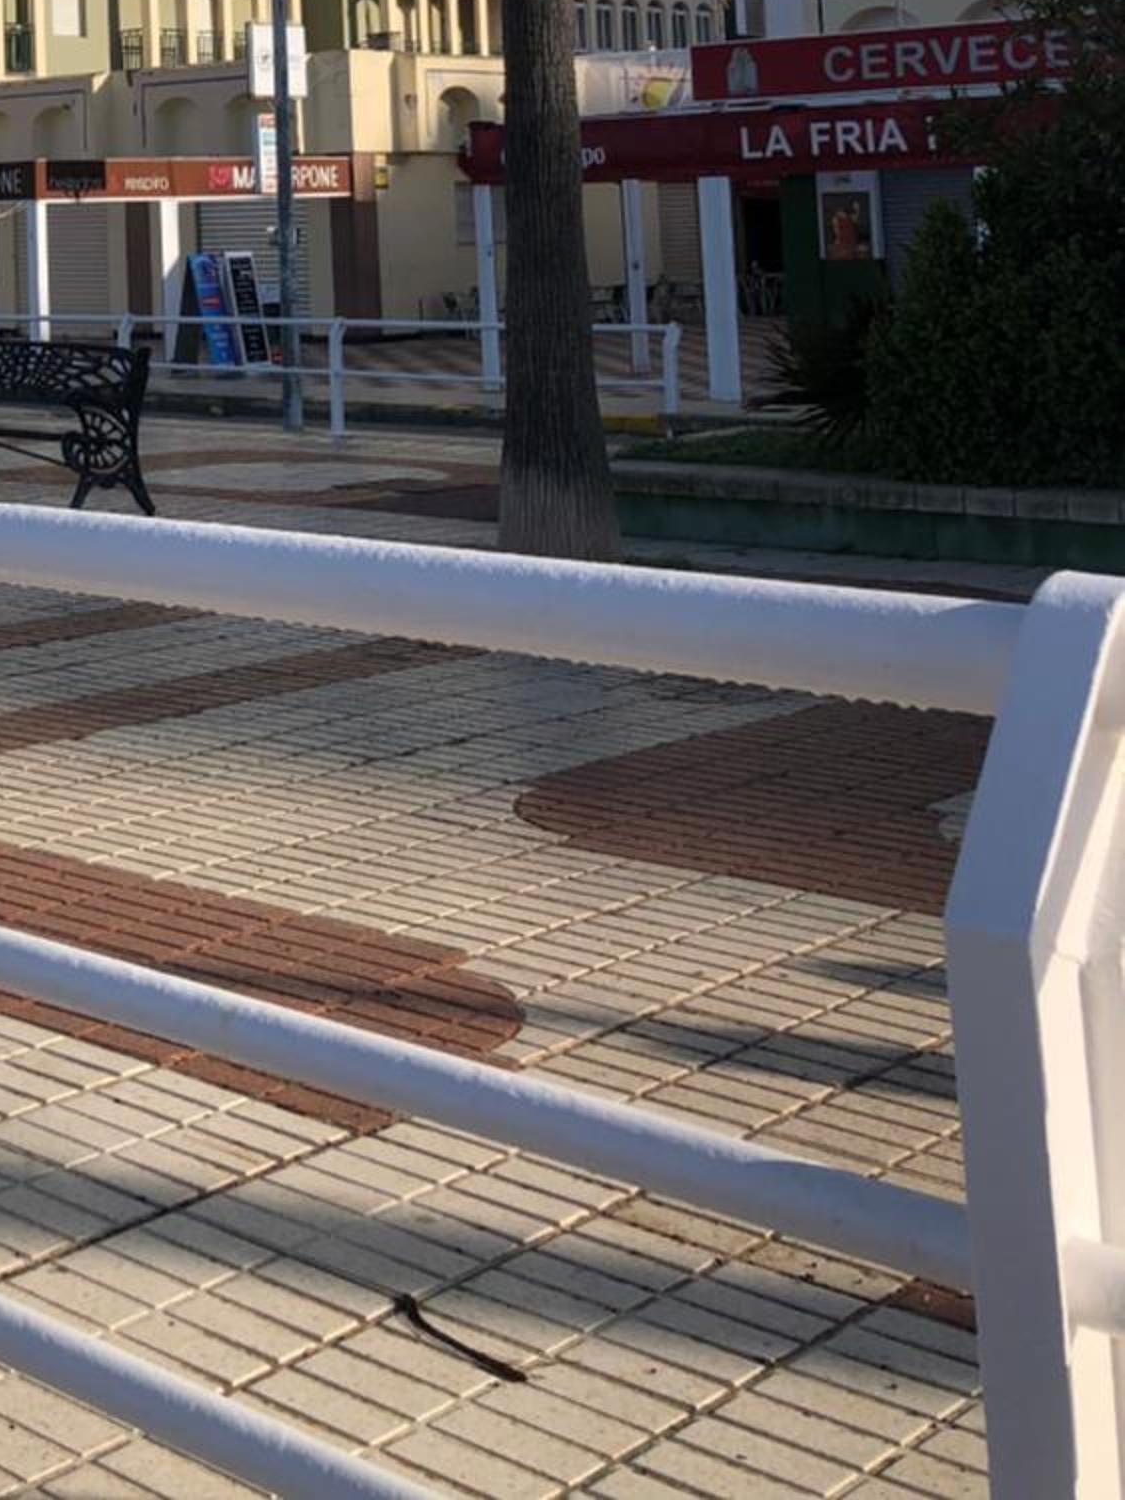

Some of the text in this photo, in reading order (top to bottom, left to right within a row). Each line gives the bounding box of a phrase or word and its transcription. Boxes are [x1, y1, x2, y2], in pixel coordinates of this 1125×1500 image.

[823, 29, 1072, 82] CERVECE
[740, 125, 793, 160] LA
[809, 118, 908, 156] FRIA
[231, 164, 339, 189] MARPONE
